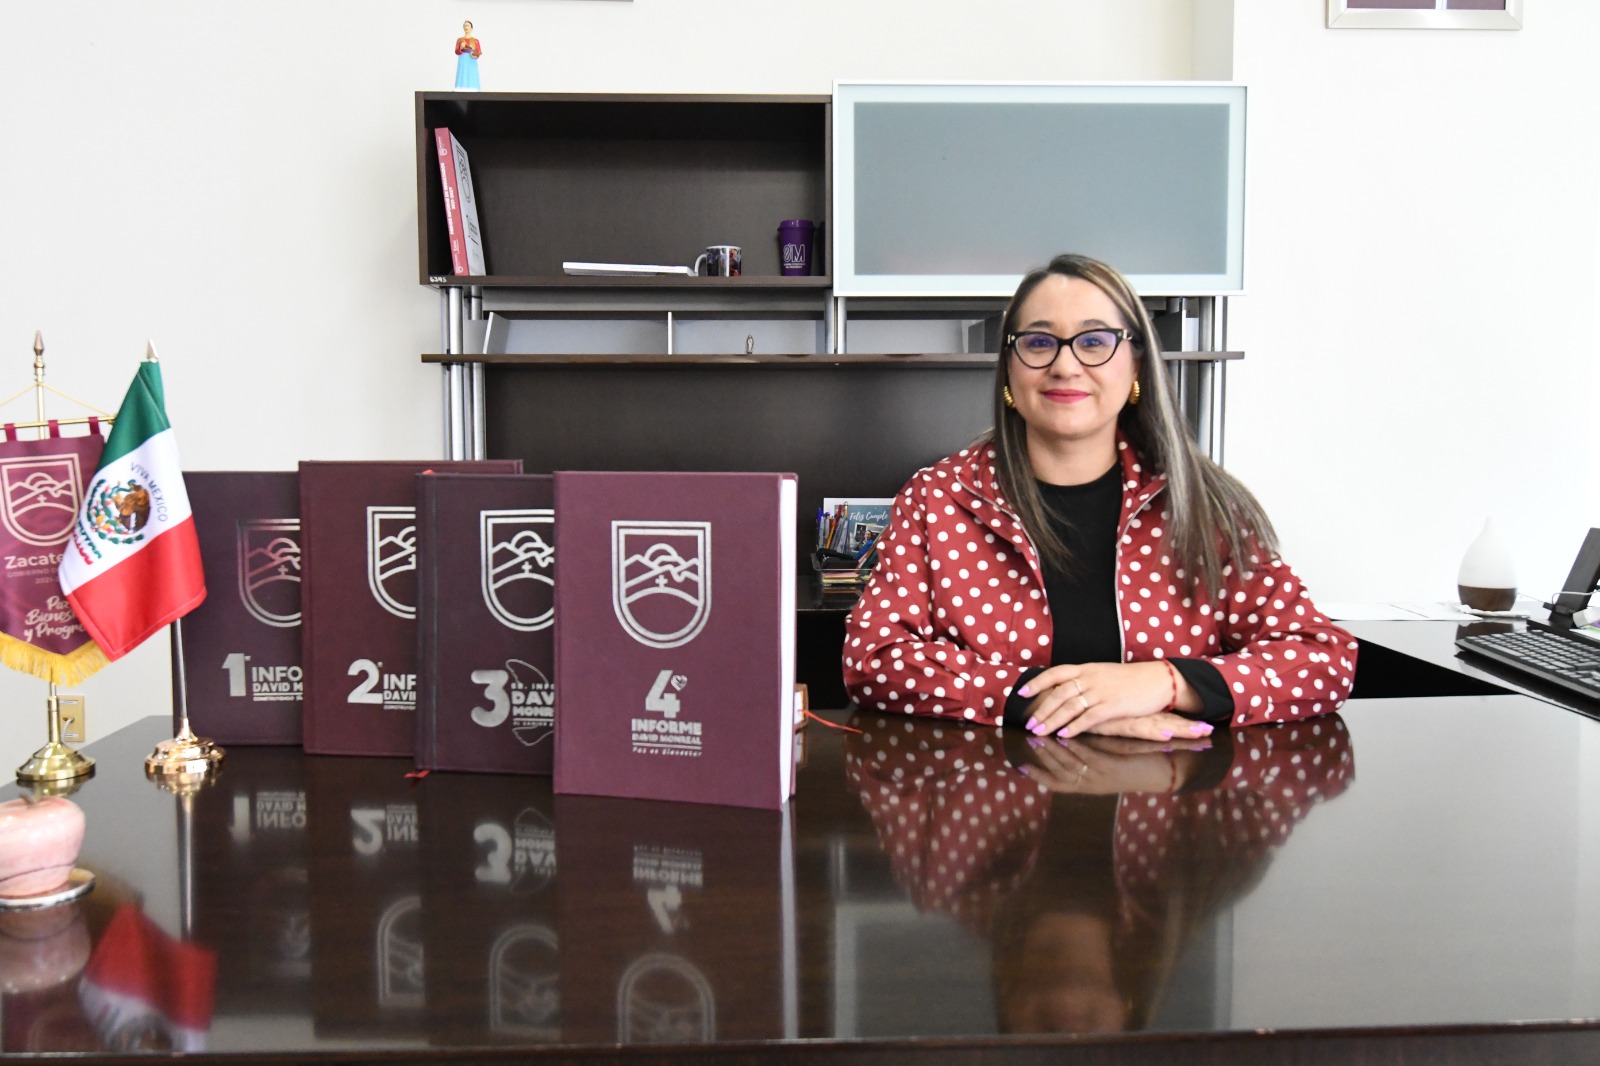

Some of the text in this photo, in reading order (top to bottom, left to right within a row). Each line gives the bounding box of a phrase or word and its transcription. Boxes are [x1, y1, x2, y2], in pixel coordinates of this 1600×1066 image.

[131, 462, 150, 480] VIVA
[23, 629, 34, 643] y
[252, 666, 303, 682] INFO
[383, 673, 417, 690] INF
[252, 682, 290, 692] DAVID
[645, 669, 681, 719] 4
[470, 669, 511, 728] 3
[511, 690, 555, 706] DAV
[631, 718, 702, 736] INFORME
[631, 733, 702, 745] DAVID MONREAL
